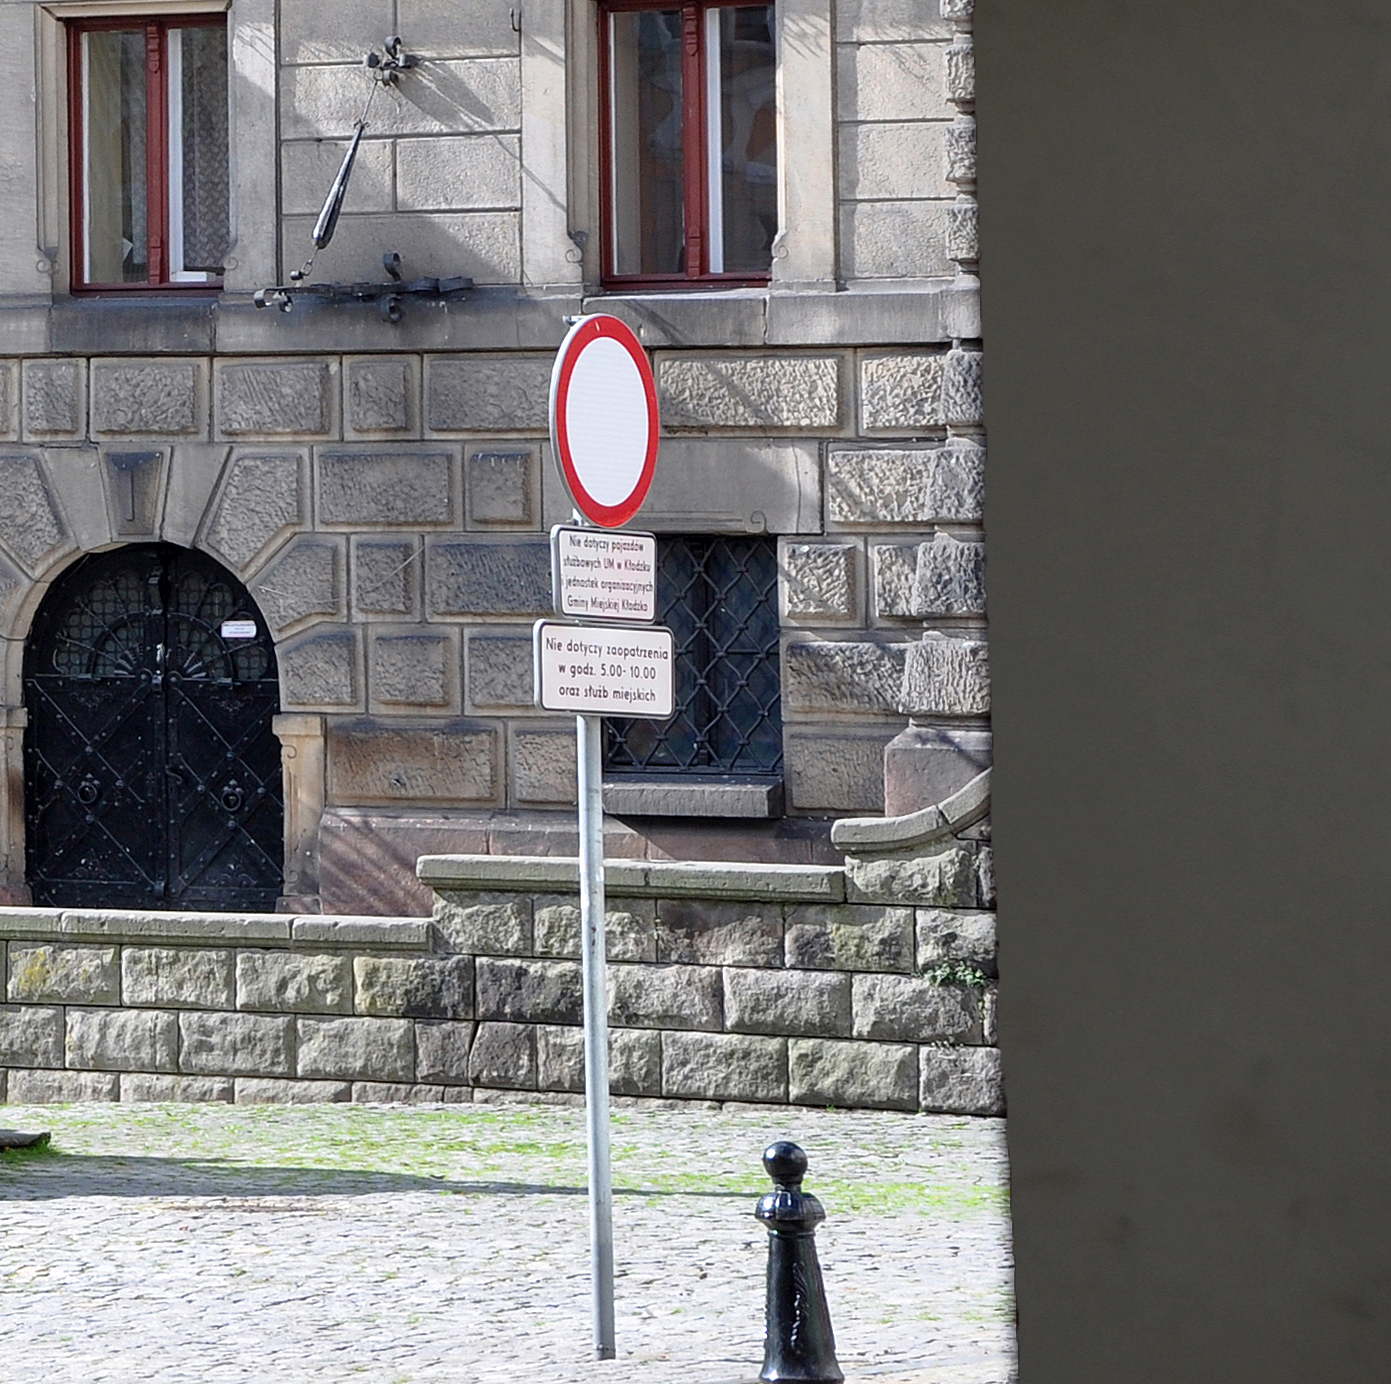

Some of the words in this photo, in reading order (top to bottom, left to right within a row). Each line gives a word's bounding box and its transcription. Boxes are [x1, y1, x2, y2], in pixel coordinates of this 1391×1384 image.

[569, 535, 581, 547] Nie
[584, 536, 609, 552] dotyczy
[603, 558, 614, 569] UM
[565, 575, 598, 589] jednostek
[567, 595, 588, 611] Gminy
[590, 596, 619, 612] Miejskiej
[546, 637, 563, 651] Nie
[566, 639, 602, 658] dotyczy
[607, 646, 668, 660] zaopatrzenia
[559, 664, 566, 673] w
[570, 662, 596, 678] godz.
[630, 666, 656, 680] 10.00
[559, 686, 579, 697] oraz
[584, 684, 609, 698] służb
[613, 687, 656, 704] miejskich
